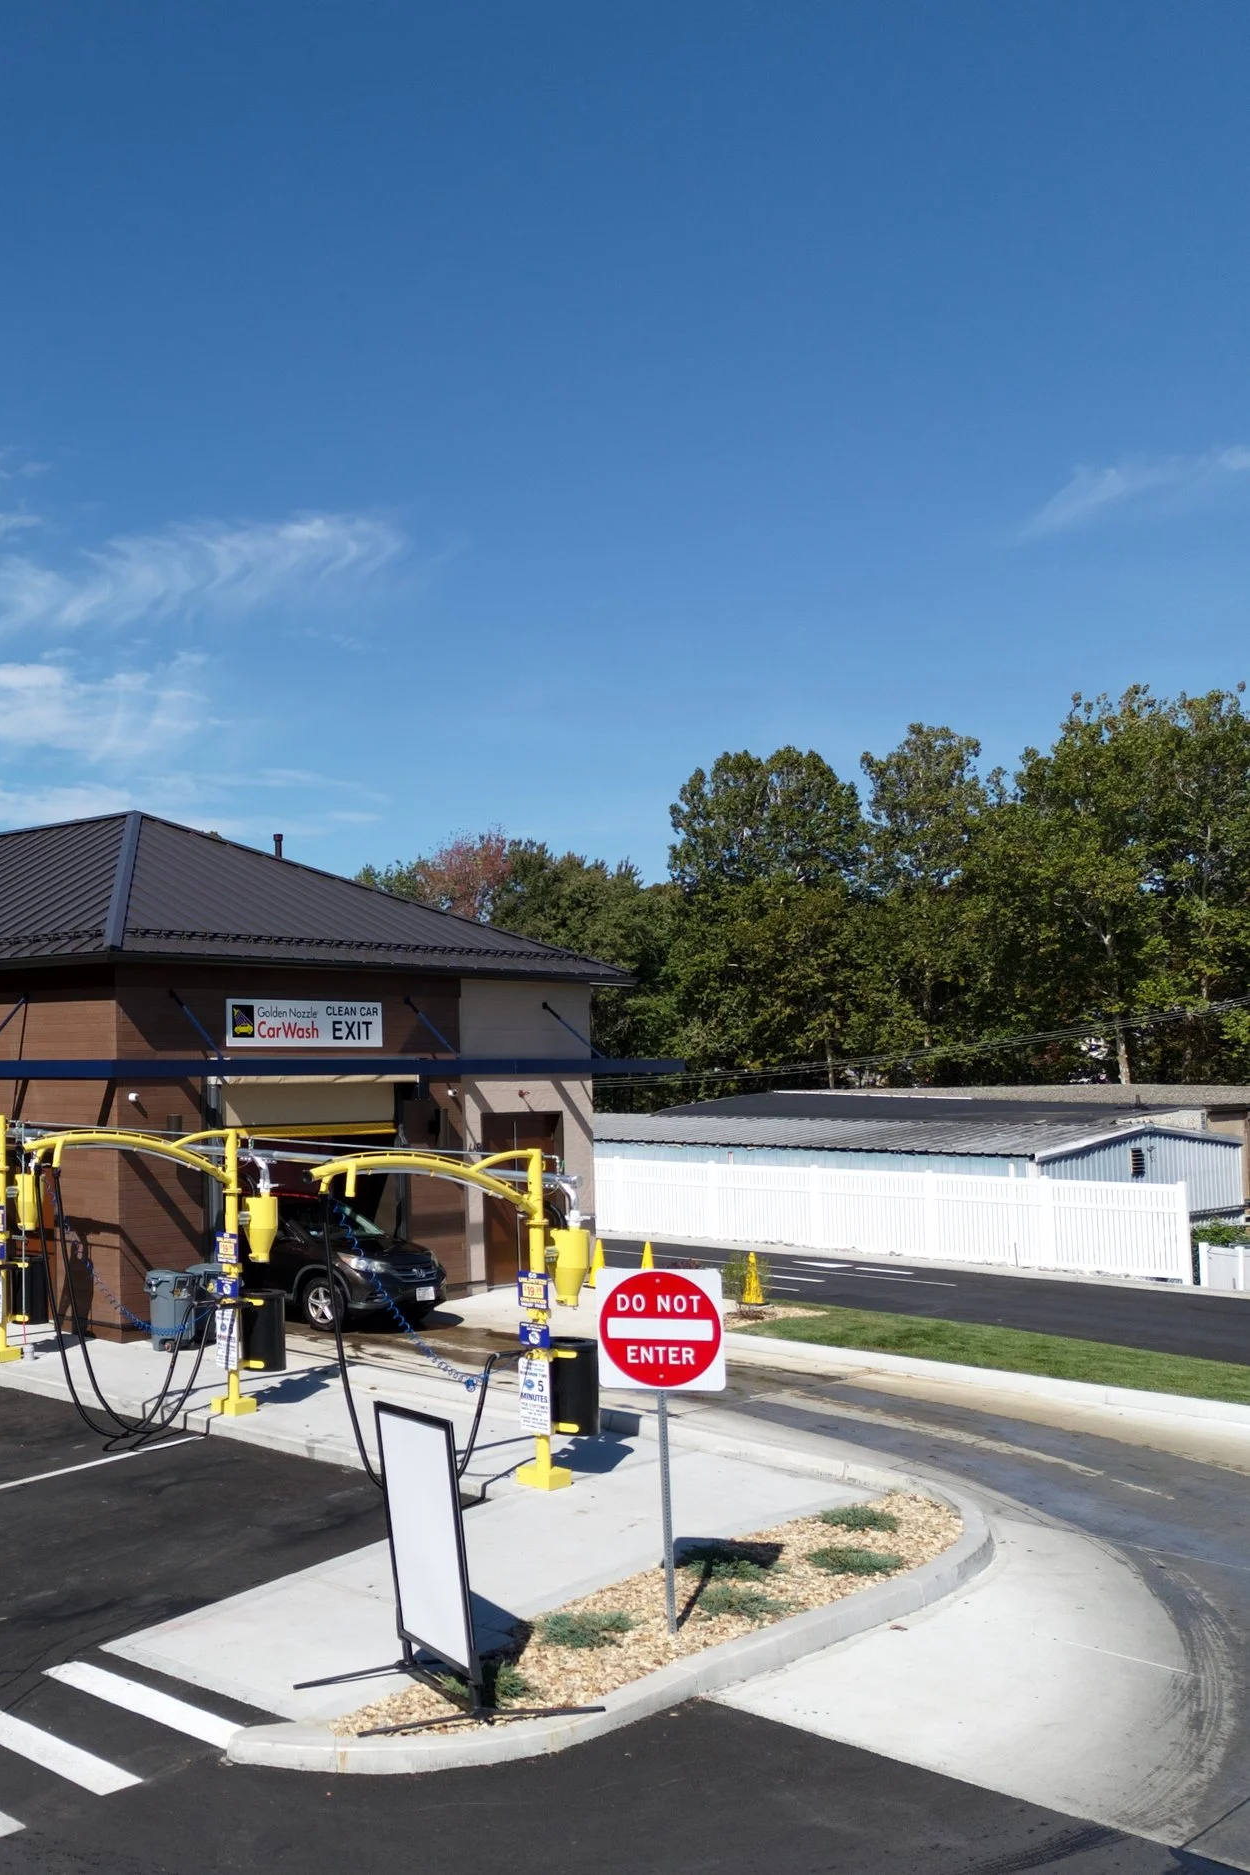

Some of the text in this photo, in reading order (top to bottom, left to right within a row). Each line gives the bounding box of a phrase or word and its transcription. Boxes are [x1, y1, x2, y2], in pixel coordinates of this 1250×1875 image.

[257, 1006, 317, 1018] Golden Nozzle
[326, 1006, 379, 1017] CLEAN CAR
[332, 1021, 373, 1040] EXIT
[616, 1294, 701, 1313] DO NOT
[627, 1345, 695, 1365] ENTER
[537, 1380, 544, 1393] 5
[520, 1392, 548, 1403] MINUTES
